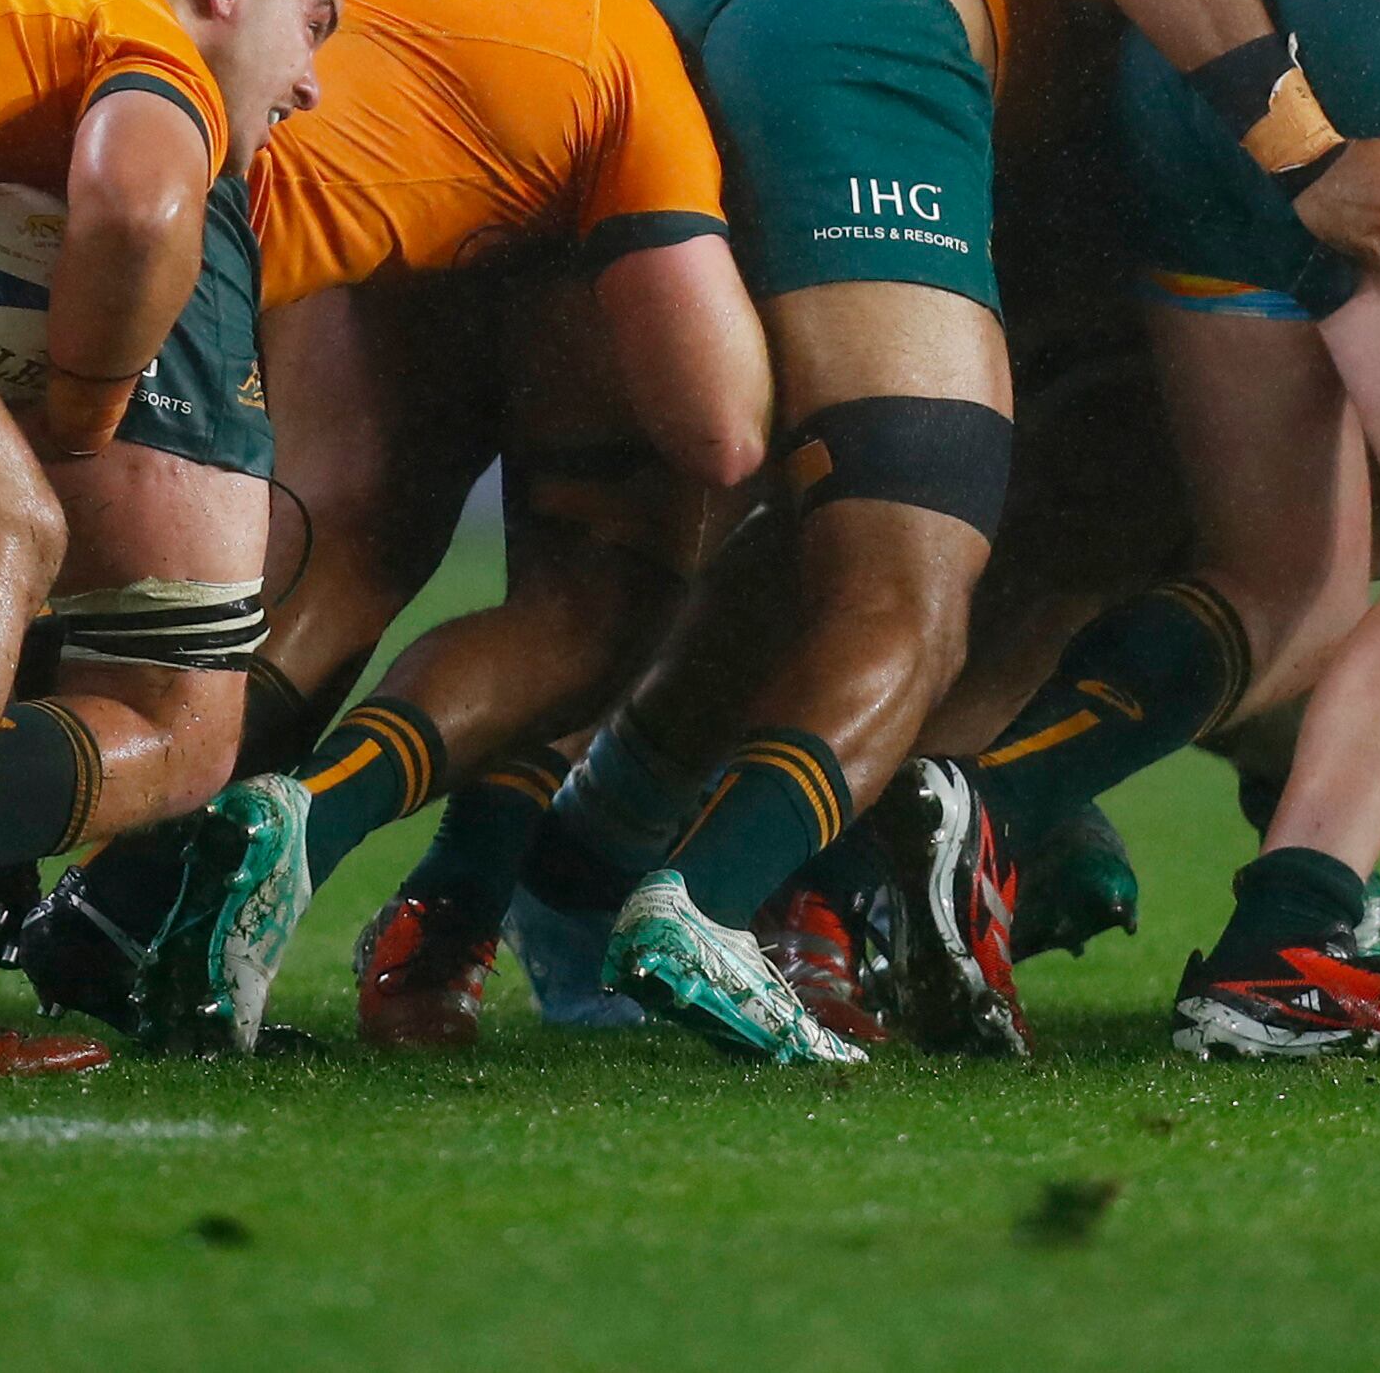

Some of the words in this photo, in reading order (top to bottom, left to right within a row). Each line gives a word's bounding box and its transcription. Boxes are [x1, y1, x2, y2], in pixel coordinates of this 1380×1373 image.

[849, 177, 942, 221] IHG
[813, 226, 885, 241] HOTELS
[889, 227, 900, 240] &
[904, 228, 969, 254] RESORTS
